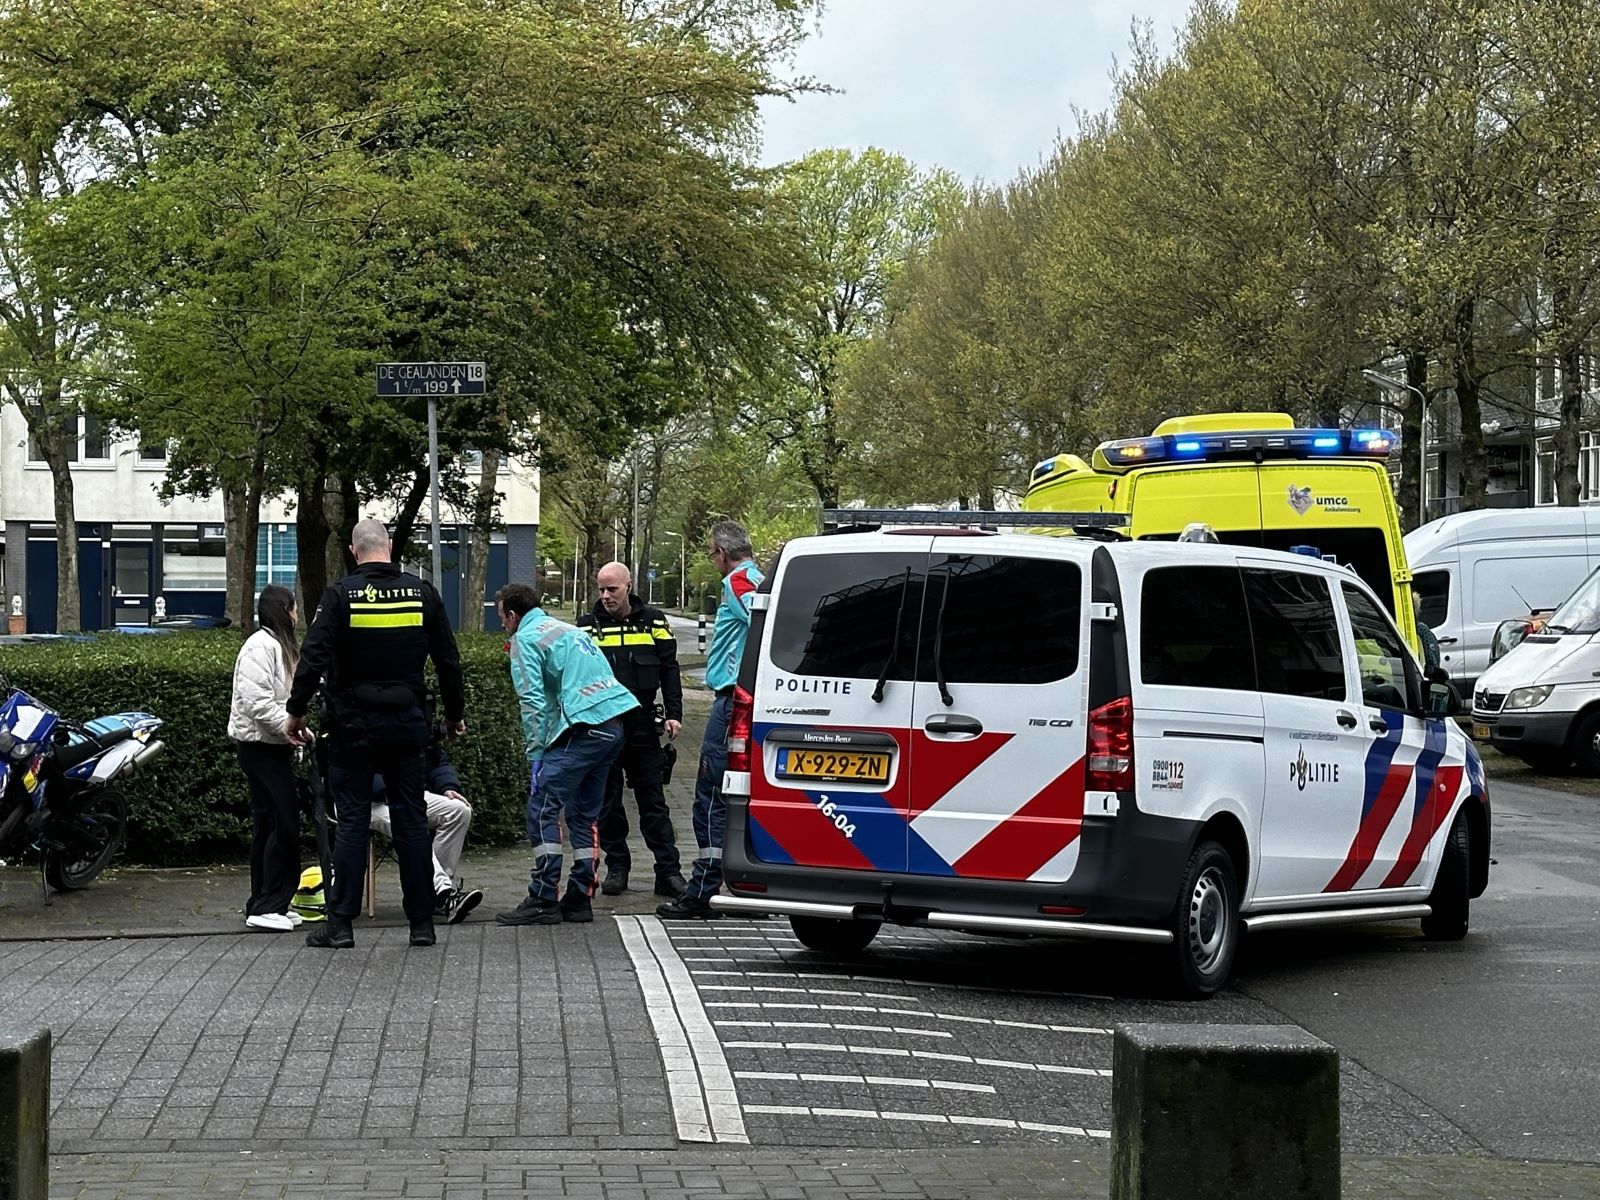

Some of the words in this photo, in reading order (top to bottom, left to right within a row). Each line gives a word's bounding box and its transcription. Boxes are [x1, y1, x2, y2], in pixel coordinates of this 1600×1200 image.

[380, 366, 394, 379] DE
[398, 365, 466, 379] GEALANDEN
[470, 366, 483, 378] 18
[393, 381, 400, 393] 1
[423, 381, 448, 393] 199
[775, 678, 851, 695] POLITIE
[1049, 719, 1074, 727] CDI
[793, 753, 881, 776] X-929-ZN
[1152, 760, 1169, 770] 0900
[1168, 761, 1184, 779] 112
[816, 794, 857, 838] 16-04
